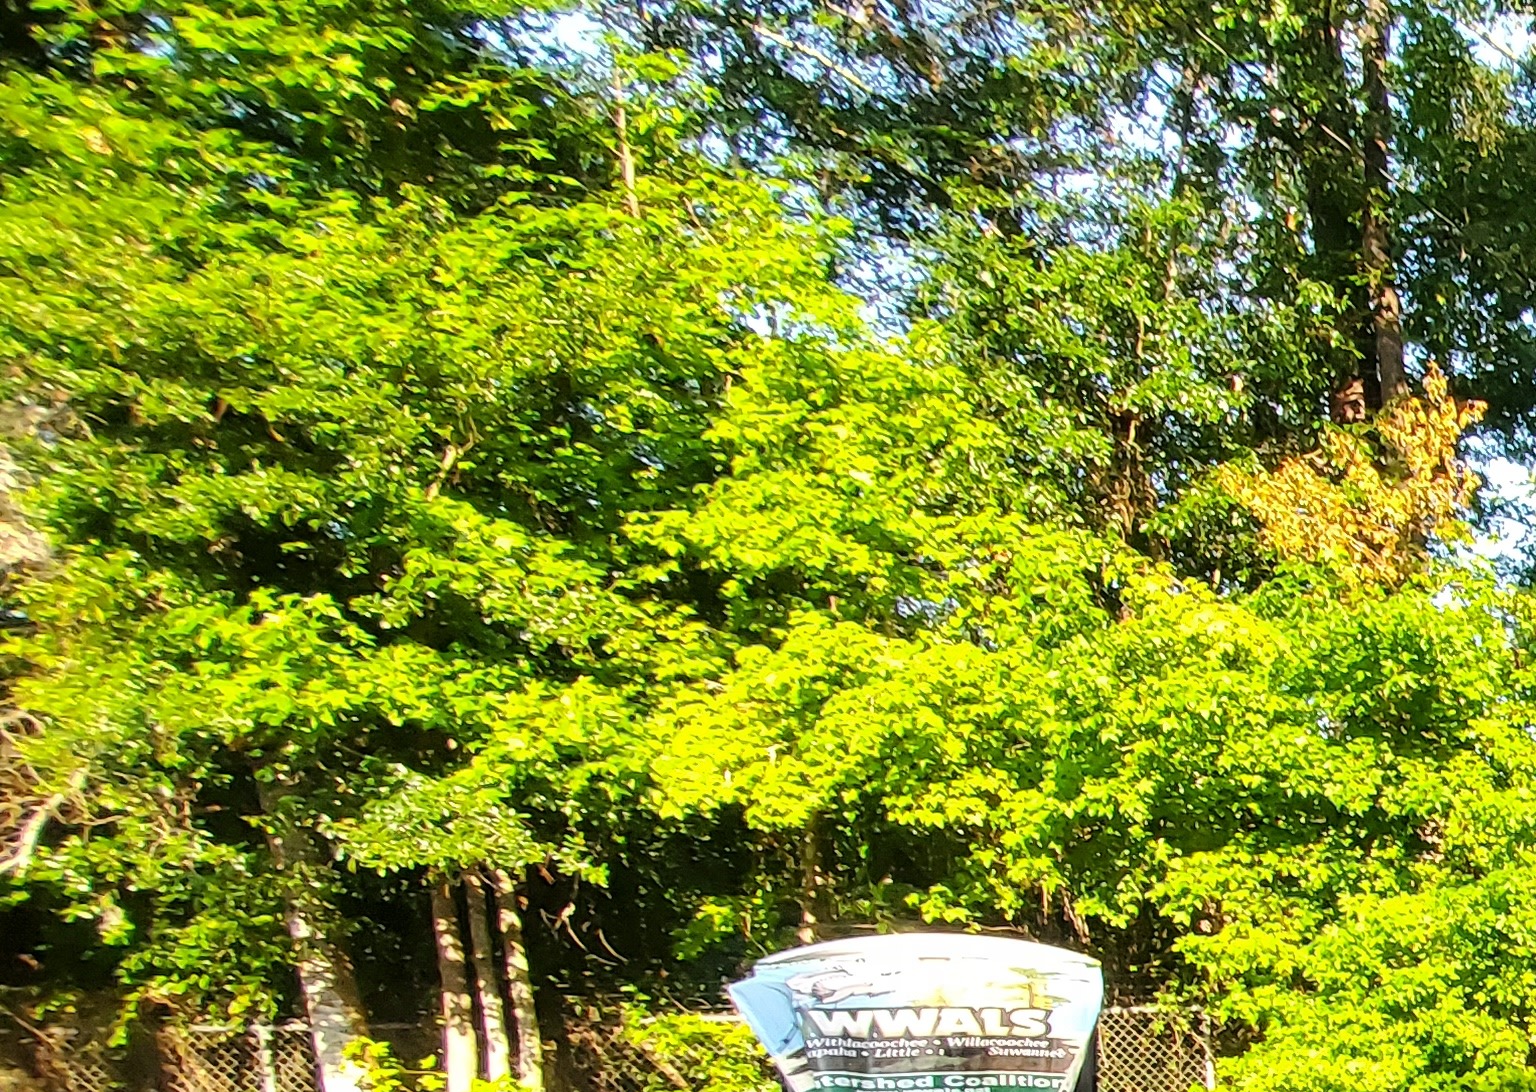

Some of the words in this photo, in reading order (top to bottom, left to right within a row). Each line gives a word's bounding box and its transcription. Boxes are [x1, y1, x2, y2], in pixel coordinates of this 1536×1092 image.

[807, 1007, 1048, 1038] WWALS
[805, 1037, 928, 1050] Withlacoochee
[807, 1047, 858, 1059] apaha
[874, 1047, 920, 1059] Little
